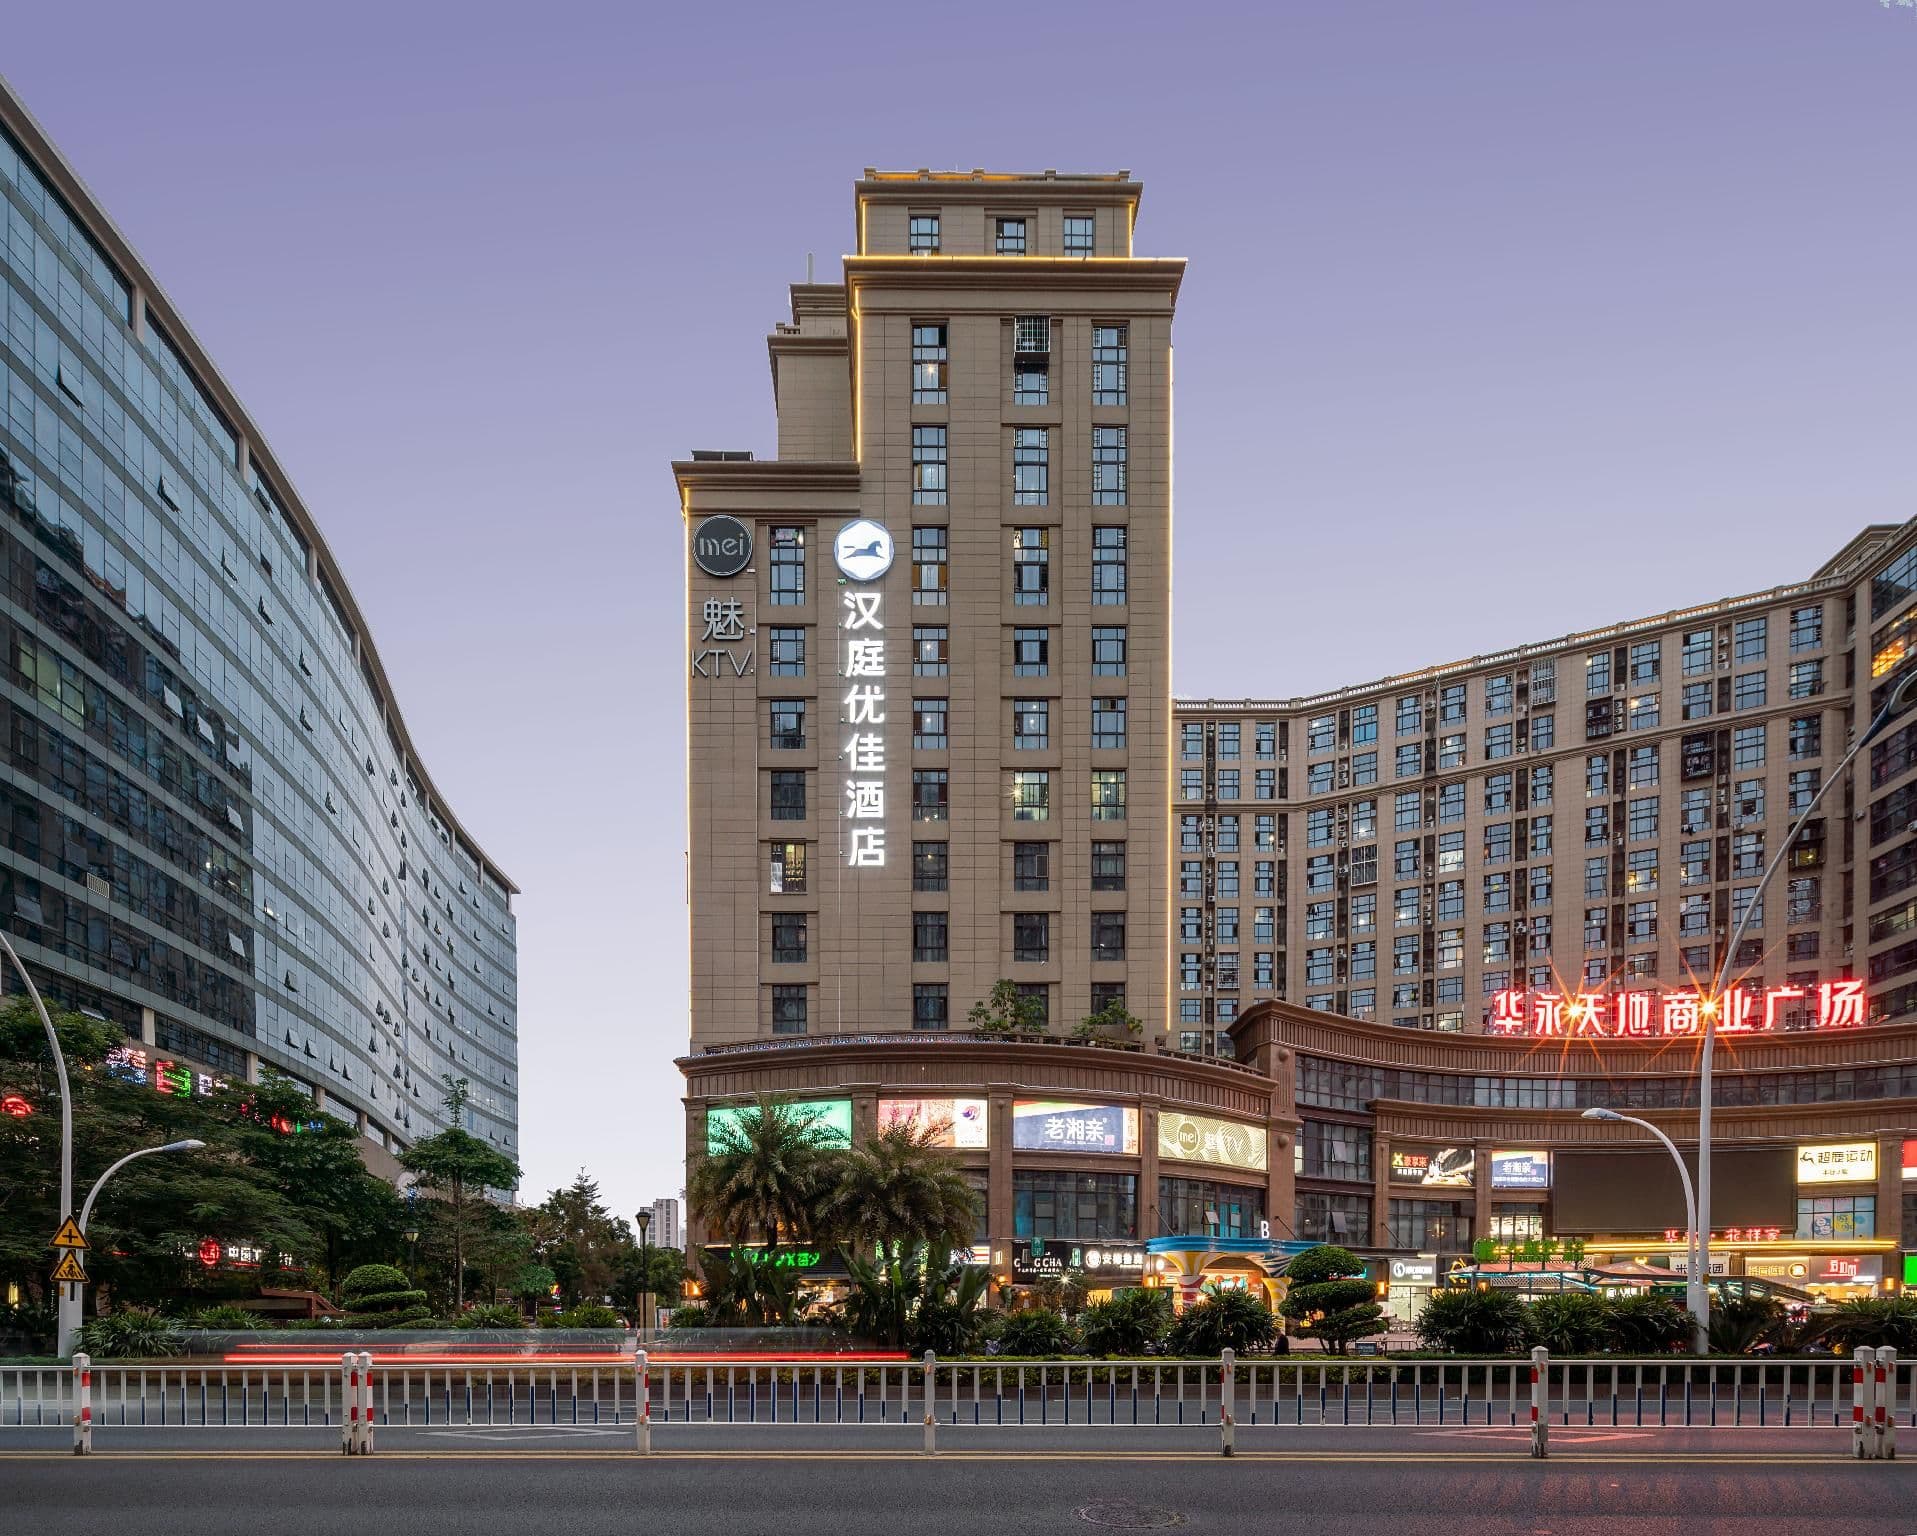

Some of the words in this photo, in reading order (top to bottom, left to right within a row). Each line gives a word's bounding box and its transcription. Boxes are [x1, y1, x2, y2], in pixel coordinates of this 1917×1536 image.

[699, 533, 744, 556] mei
[702, 596, 745, 641] 魅
[691, 649, 751, 678] KTV
[843, 591, 886, 867] 汉庭优佳酒店
[1493, 979, 1866, 1035] 华永天地商业广场
[1044, 1116, 1104, 1141] 老湘亲
[1260, 1220, 1270, 1239] B
